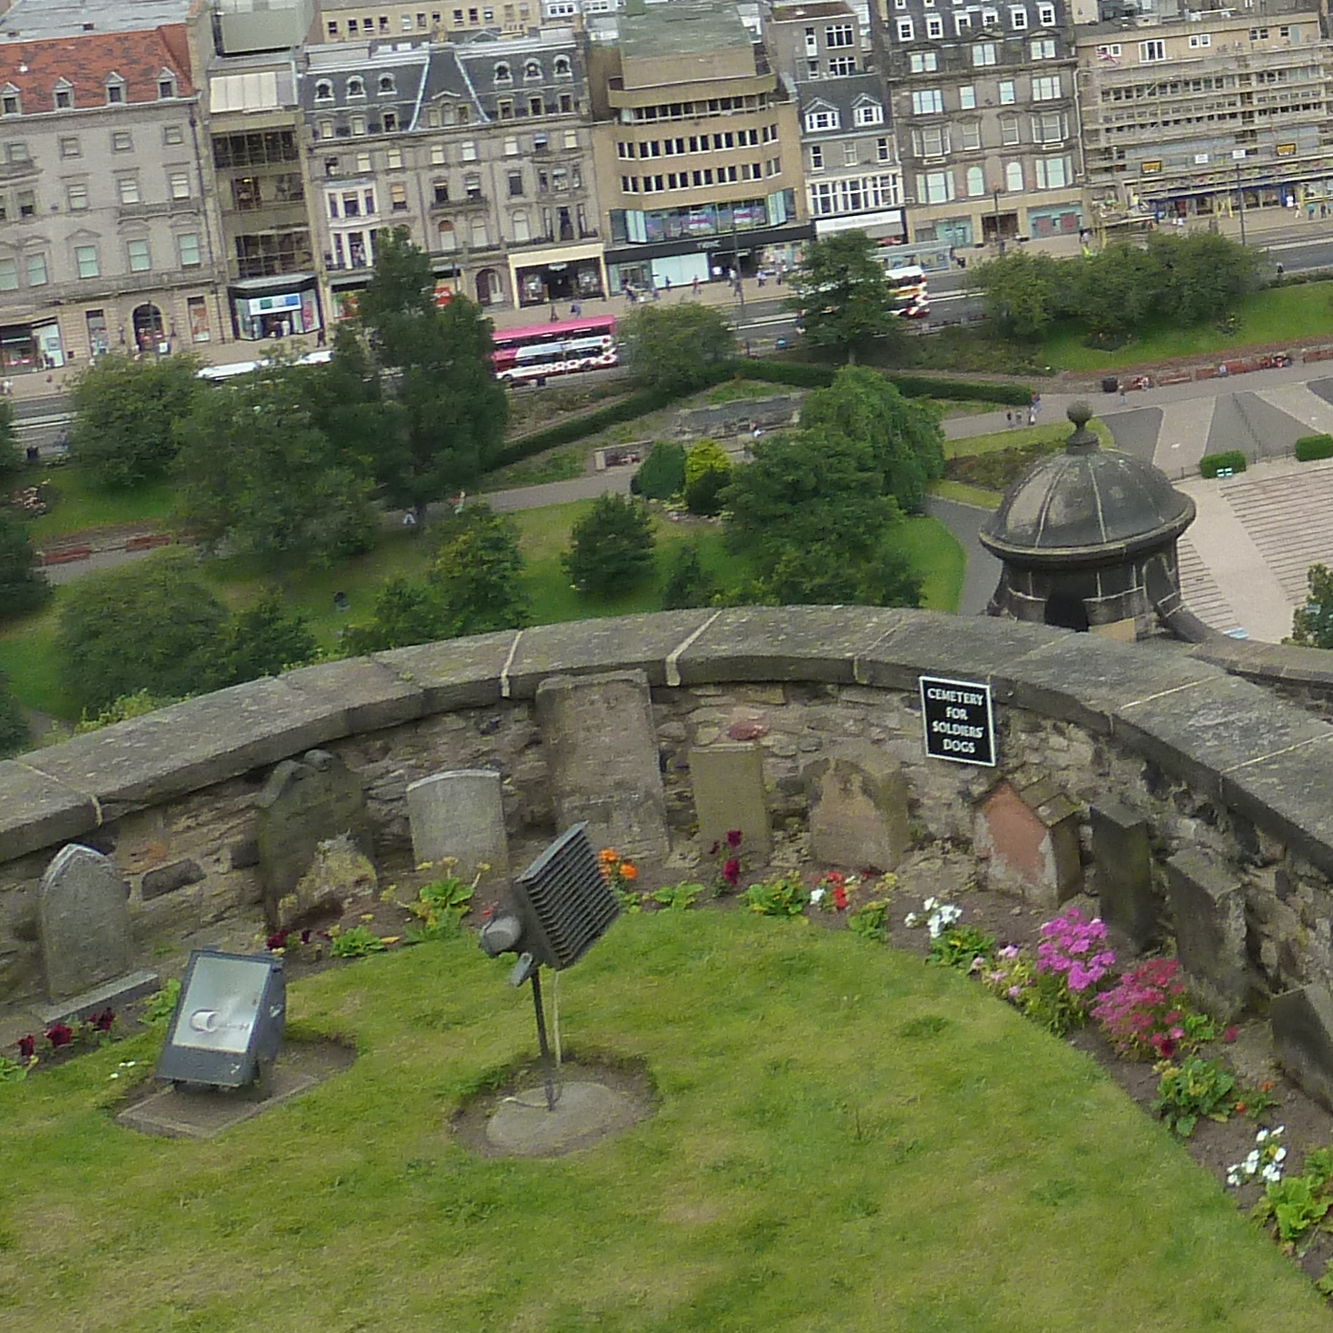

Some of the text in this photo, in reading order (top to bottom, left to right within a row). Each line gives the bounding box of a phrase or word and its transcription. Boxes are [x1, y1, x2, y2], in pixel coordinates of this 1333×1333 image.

[927, 688, 984, 705] CEMETERY
[945, 707, 968, 720] FOR
[943, 739, 976, 753] DOGS
